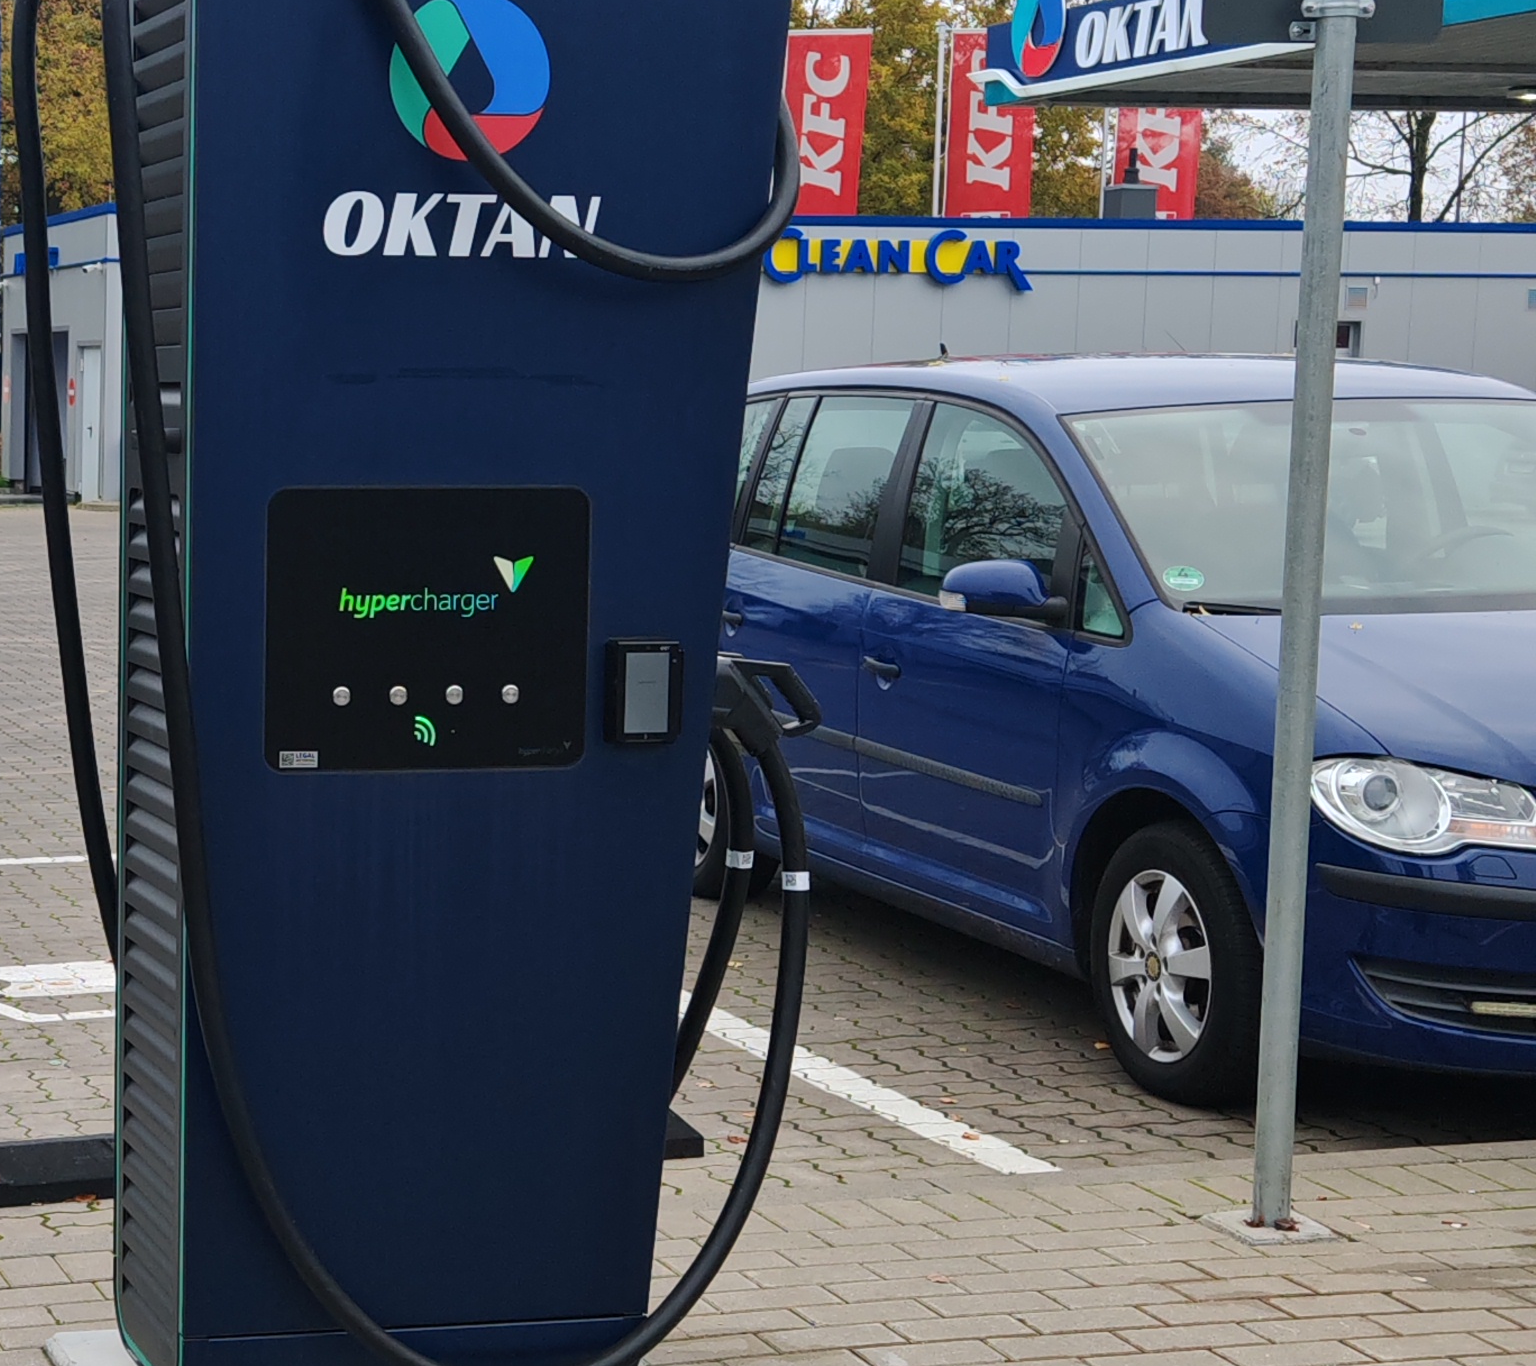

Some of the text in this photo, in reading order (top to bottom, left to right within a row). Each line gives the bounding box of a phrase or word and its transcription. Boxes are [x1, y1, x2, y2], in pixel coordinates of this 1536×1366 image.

[800, 51, 851, 196] KFC
[1135, 107, 1182, 193] KF
[323, 190, 602, 259] OKTAN
[763, 227, 1034, 292] CLEAN CAR
[339, 587, 499, 619] hypercharger
